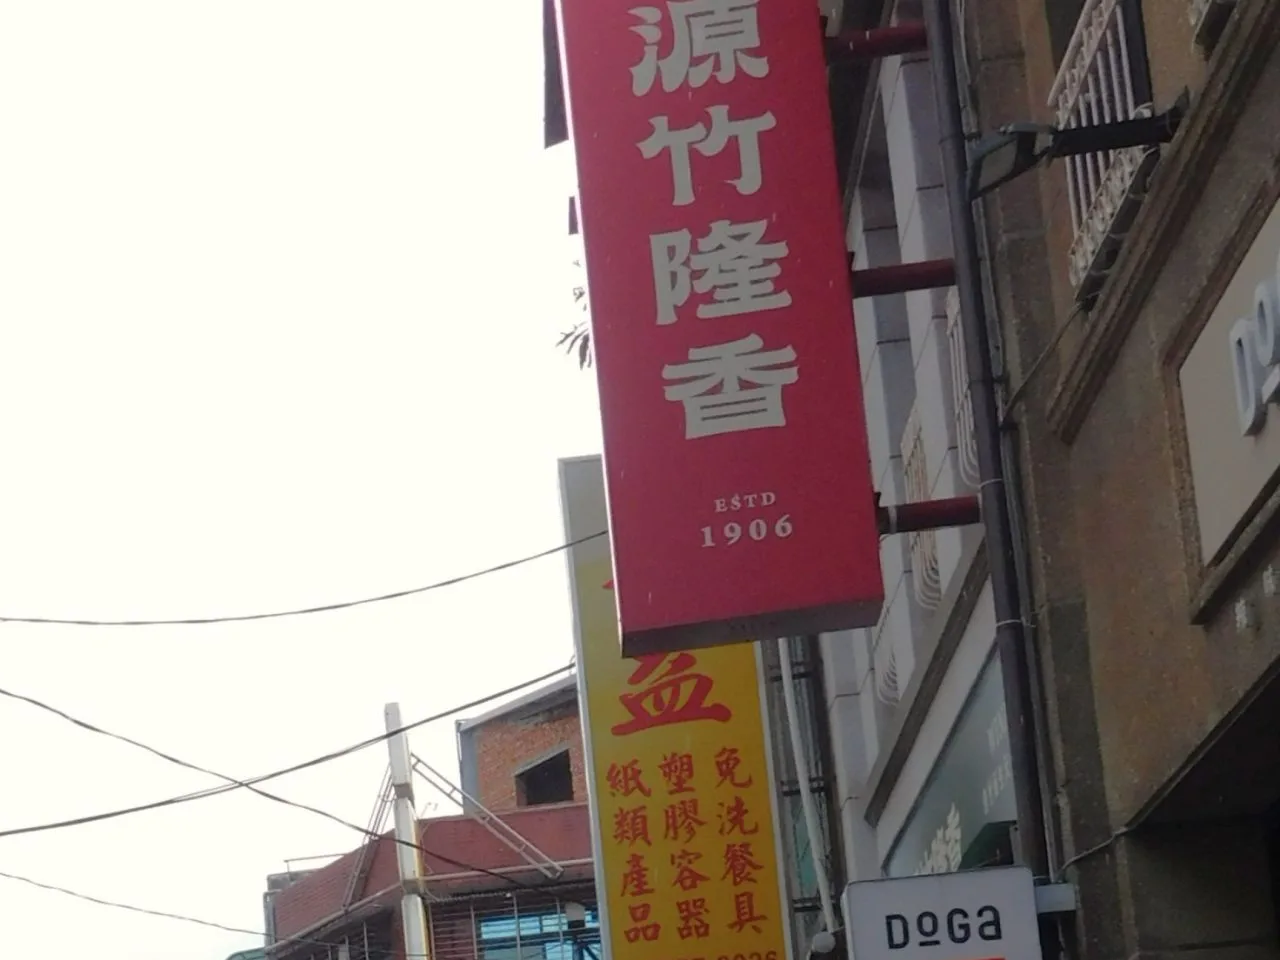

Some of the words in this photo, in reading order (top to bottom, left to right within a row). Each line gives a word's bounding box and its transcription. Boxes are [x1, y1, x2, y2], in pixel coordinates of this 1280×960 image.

[700, 517, 794, 549] 1906
[714, 490, 778, 513] ESTD
[606, 758, 662, 943] 紙類產品
[658, 752, 711, 940] 塑膠容器
[713, 746, 768, 934] 免洗餐具
